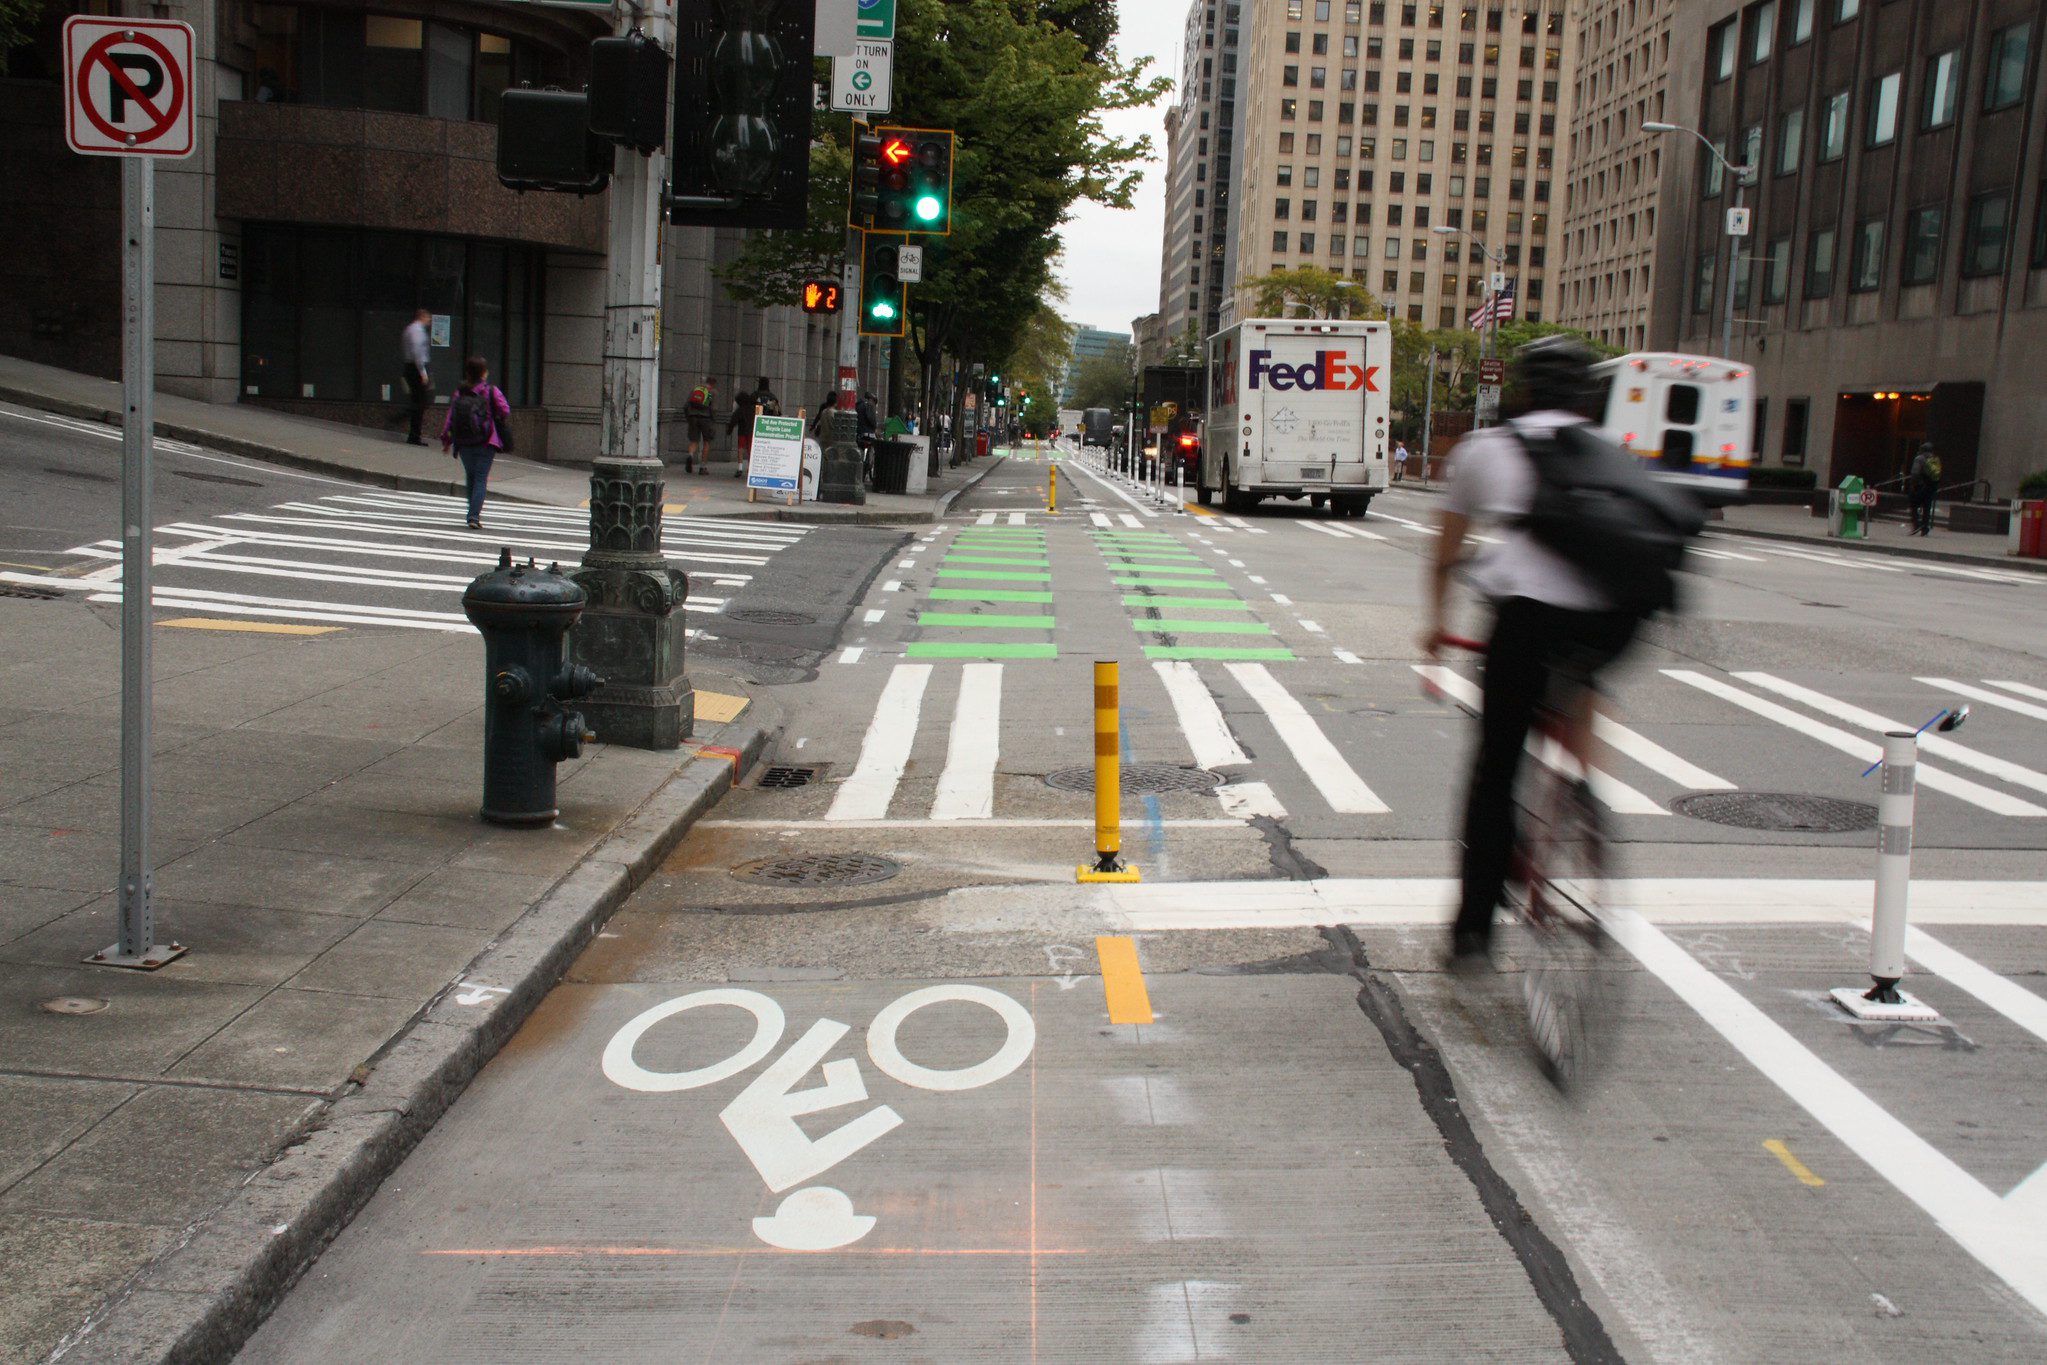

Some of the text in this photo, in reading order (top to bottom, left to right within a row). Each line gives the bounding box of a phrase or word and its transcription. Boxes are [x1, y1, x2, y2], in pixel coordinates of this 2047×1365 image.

[864, 45, 888, 57] TURN
[855, 59, 869, 69] ON
[845, 93, 876, 106] ONLY
[826, 287, 836, 309] 2
[1249, 350, 1380, 392] FedEx
